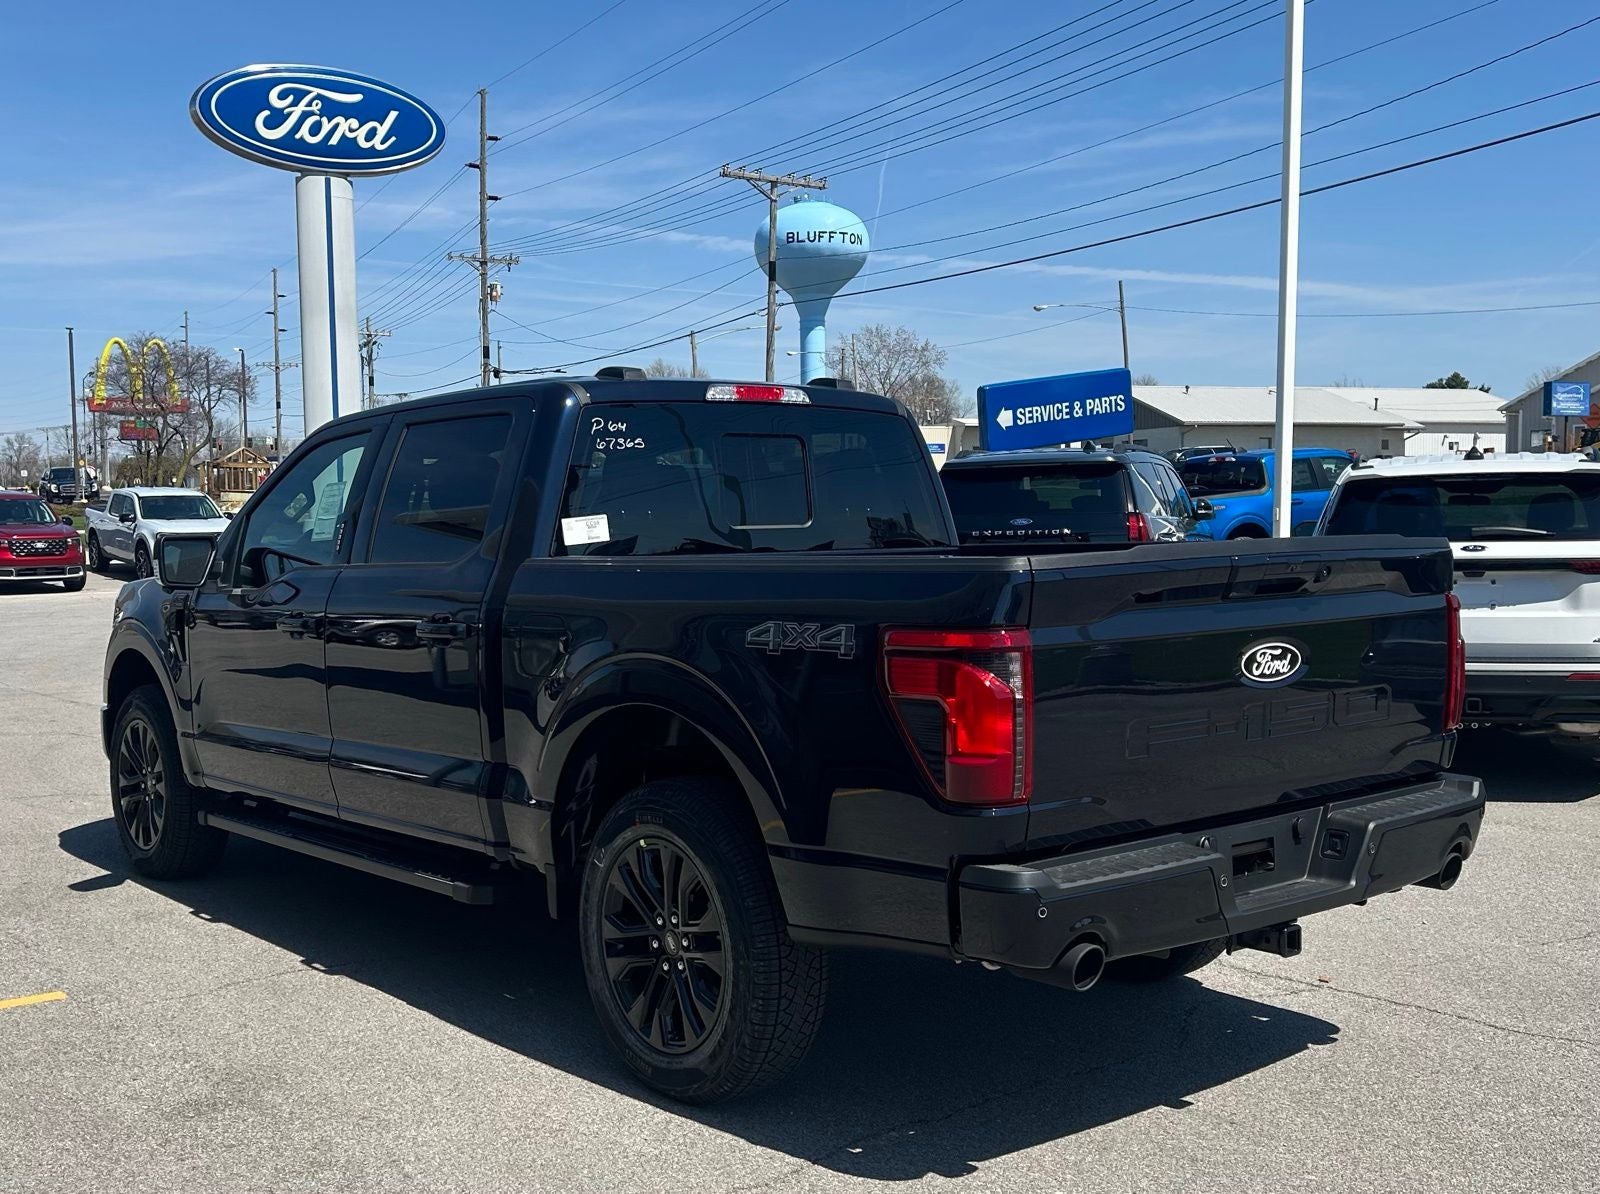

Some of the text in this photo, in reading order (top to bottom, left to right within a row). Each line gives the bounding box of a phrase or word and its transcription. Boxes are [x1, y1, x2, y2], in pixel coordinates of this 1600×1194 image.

[254, 82, 399, 151] Ford
[786, 231, 863, 246] BLUFFTON
[1016, 394, 1126, 425] SERVICE & PARTS
[972, 528, 1072, 537] EXPEDITION
[1252, 648, 1293, 677] Ford
[1126, 683, 1393, 760] F-150
